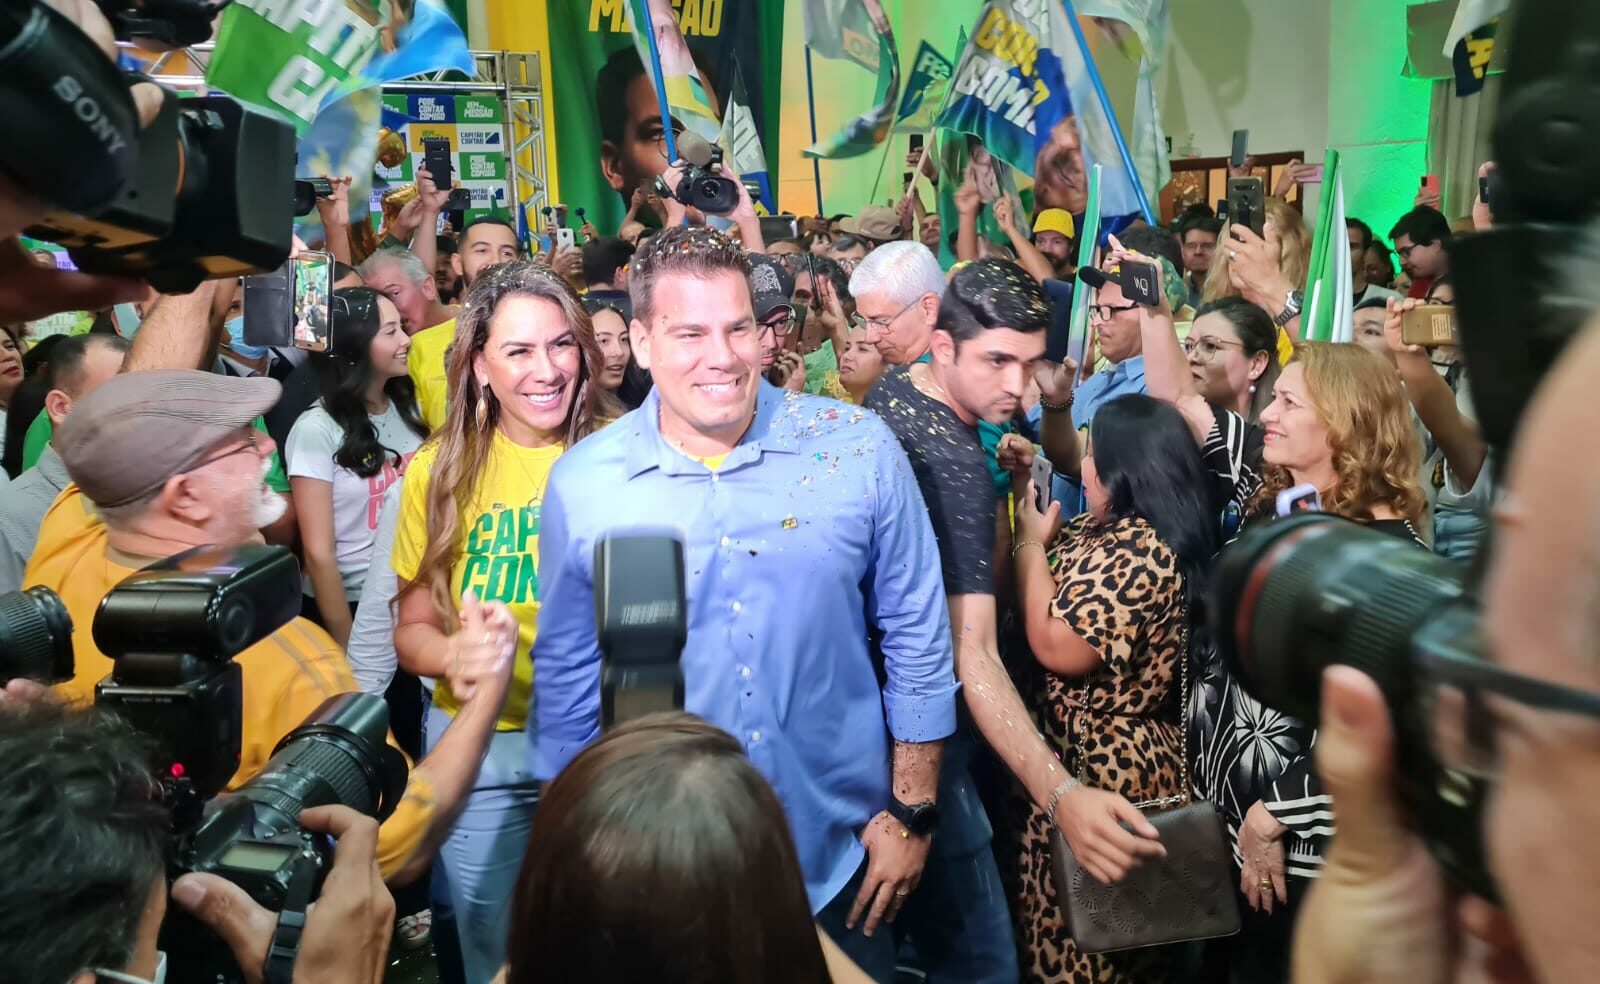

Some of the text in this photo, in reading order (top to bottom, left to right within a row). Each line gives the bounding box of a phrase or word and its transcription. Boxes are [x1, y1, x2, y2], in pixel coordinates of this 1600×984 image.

[53, 76, 126, 153] SONY
[955, 55, 1036, 136] COMI
[467, 506, 541, 555] CAP
